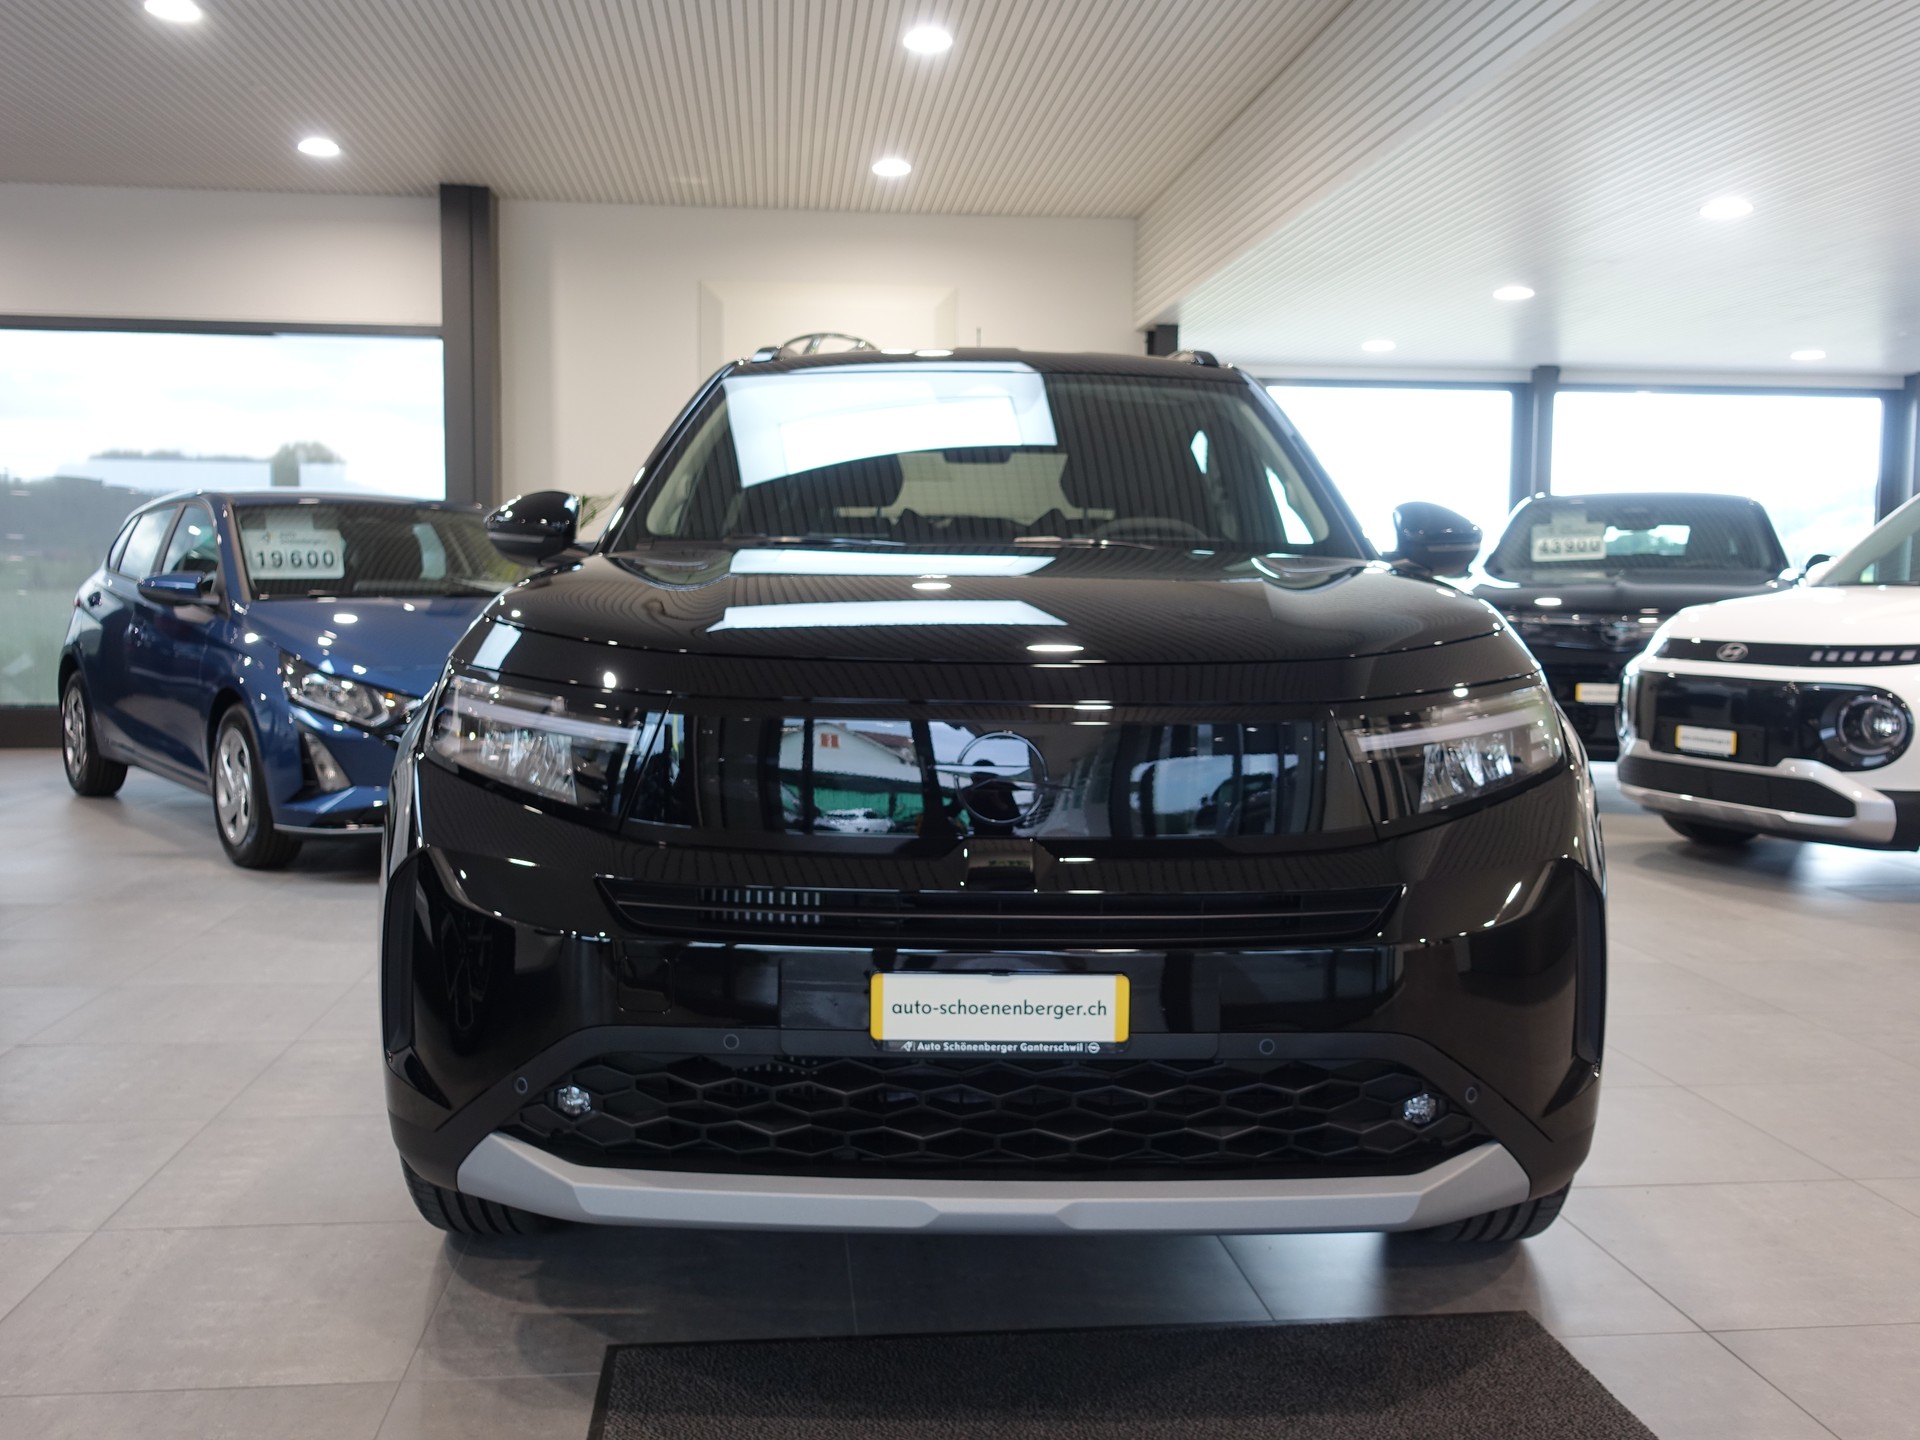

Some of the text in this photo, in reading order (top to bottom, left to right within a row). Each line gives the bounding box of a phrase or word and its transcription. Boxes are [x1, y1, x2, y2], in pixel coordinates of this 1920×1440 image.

[891, 998, 1108, 1019] auto-schoenenberger.ch
[917, 1041, 1084, 1054] Auto Schönenberger Ganterschwil
